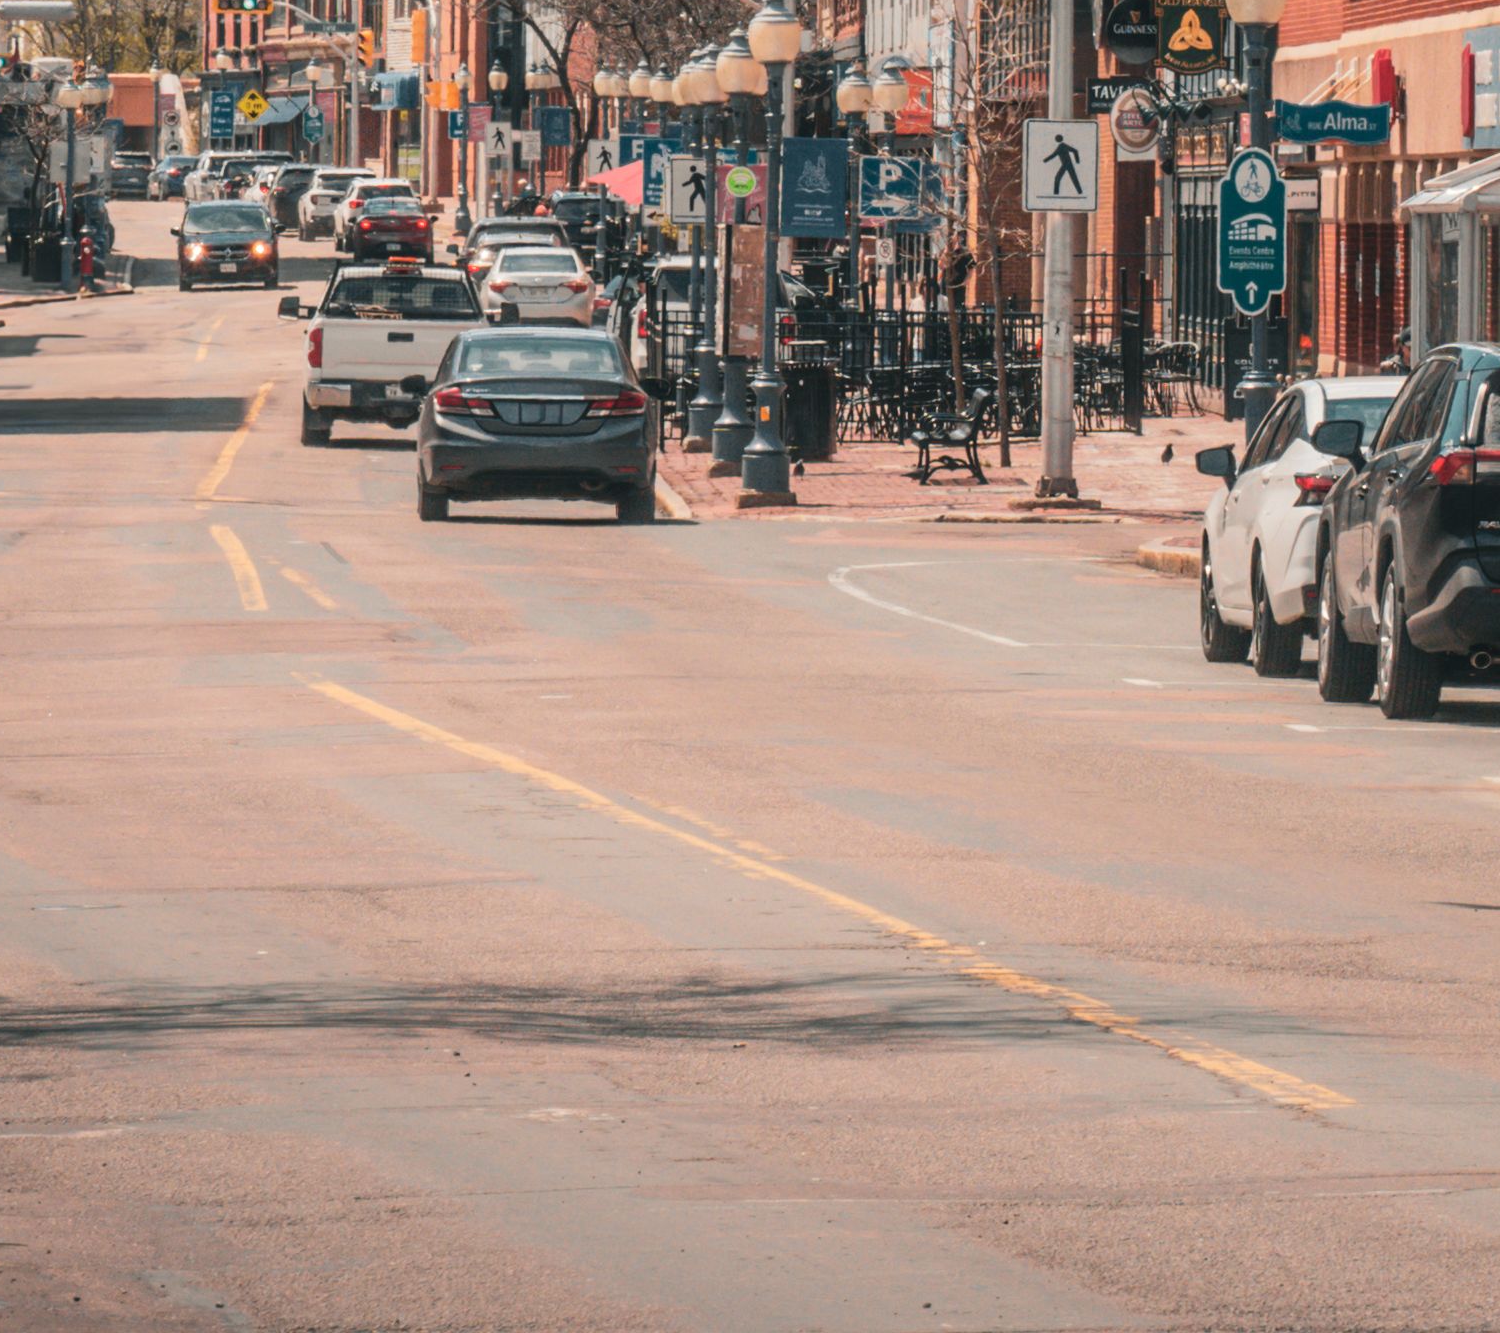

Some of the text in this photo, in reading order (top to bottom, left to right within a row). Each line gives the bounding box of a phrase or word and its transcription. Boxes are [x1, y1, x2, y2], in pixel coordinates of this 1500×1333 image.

[1324, 112, 1368, 131] Alma
[1228, 246, 1275, 256] Events Centre
